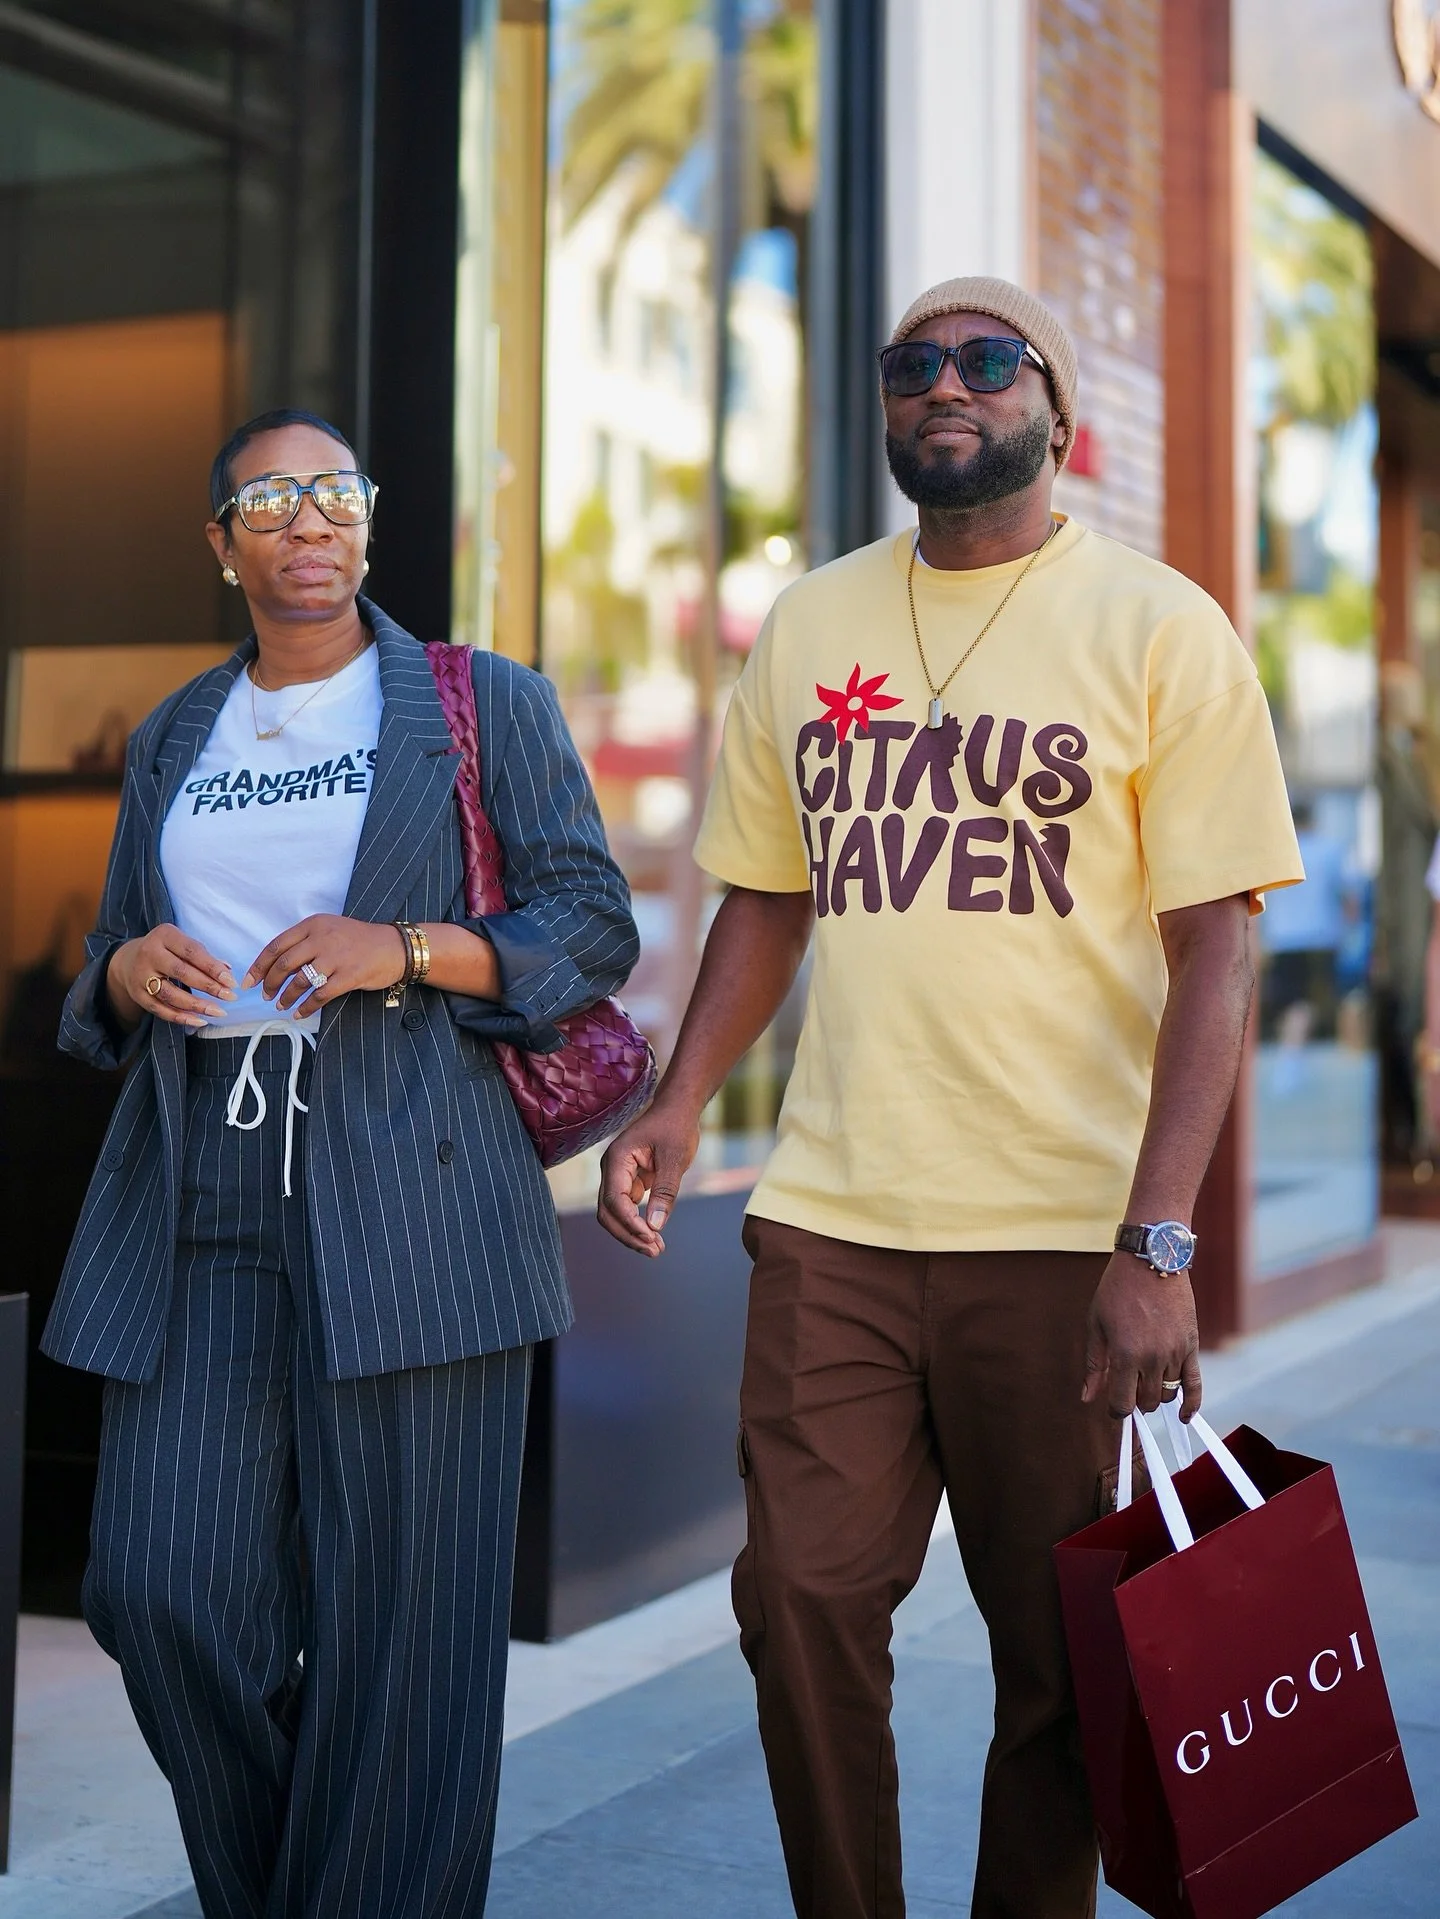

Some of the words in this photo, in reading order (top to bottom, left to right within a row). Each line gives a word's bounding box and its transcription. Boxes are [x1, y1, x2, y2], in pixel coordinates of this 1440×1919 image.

[192, 772, 367, 815] FAVORITE
[796, 713, 1092, 818] CITRUS
[802, 812, 1074, 918] HAVEN
[1176, 1631, 1366, 1775] GUCCI
